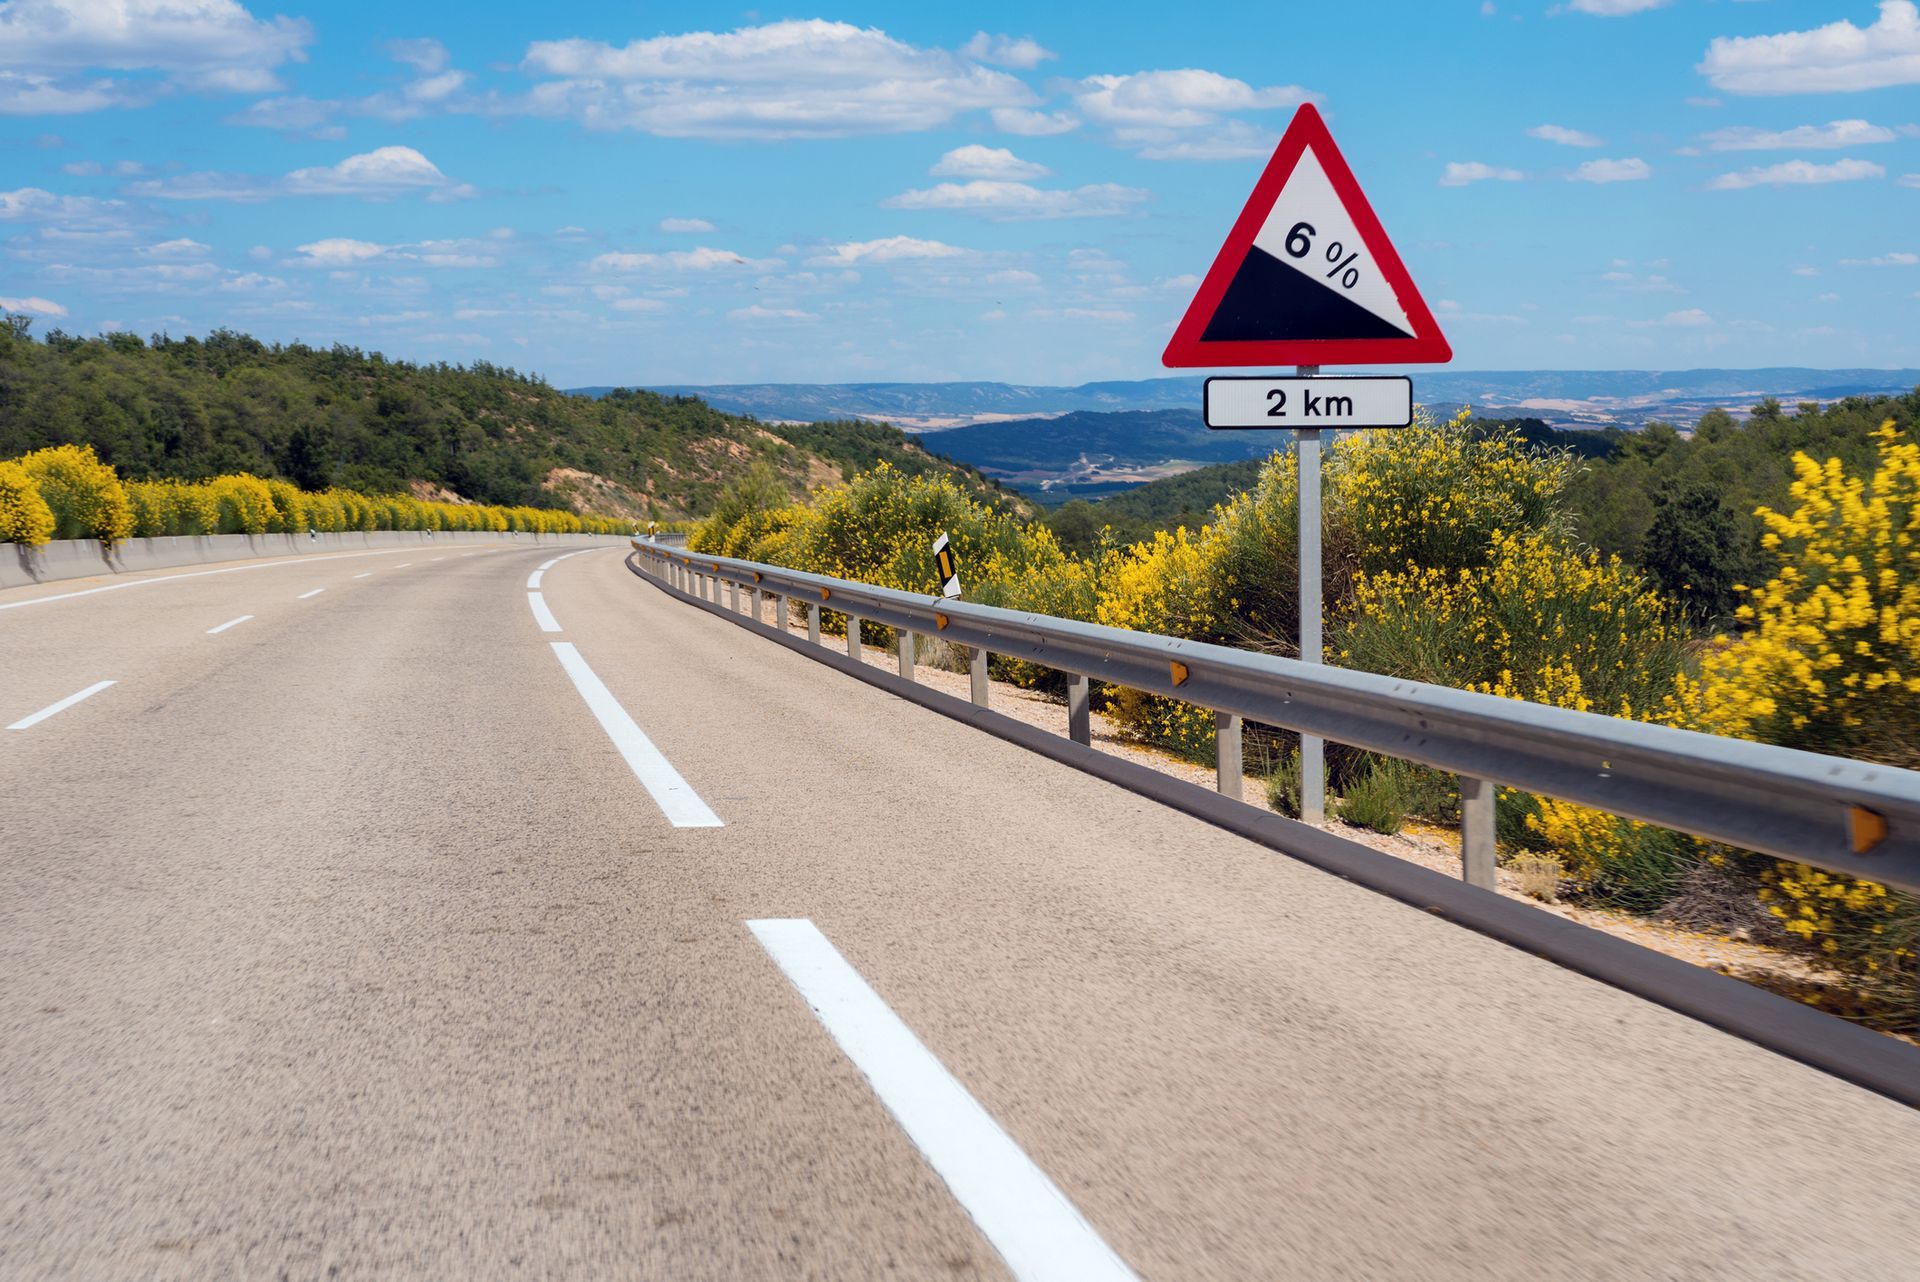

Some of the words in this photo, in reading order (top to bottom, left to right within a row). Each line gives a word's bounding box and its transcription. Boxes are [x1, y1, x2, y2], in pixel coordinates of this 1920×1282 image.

[1285, 221, 1316, 258] 6
[1325, 241, 1359, 289] %
[1266, 389, 1287, 417] 2
[1304, 389, 1353, 416] km
